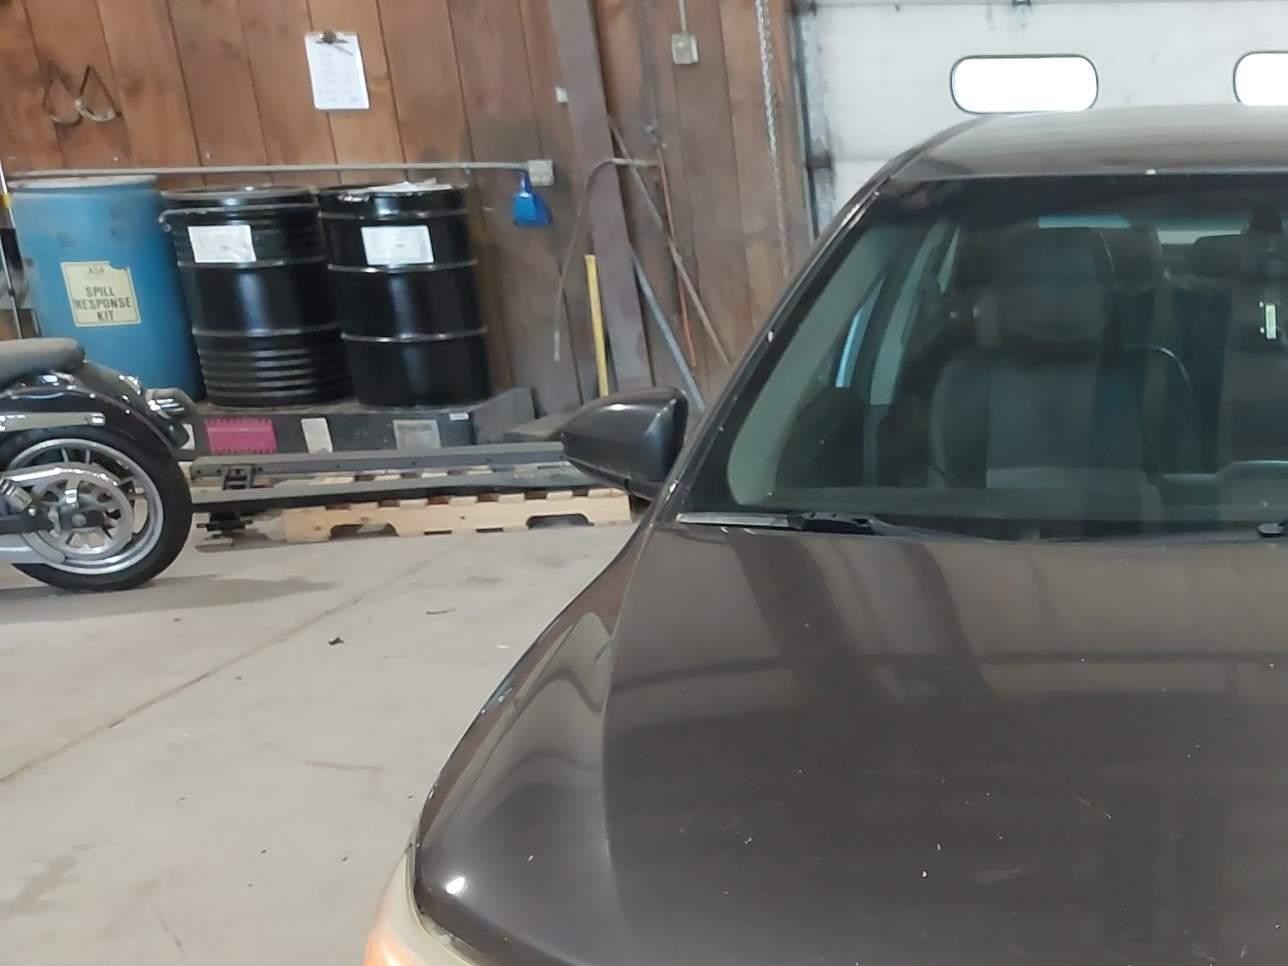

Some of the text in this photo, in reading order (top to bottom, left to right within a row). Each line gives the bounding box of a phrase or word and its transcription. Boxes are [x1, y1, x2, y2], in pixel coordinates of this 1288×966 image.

[85, 286, 115, 298] SPILL
[73, 297, 133, 310] RESPONSE
[96, 310, 114, 321] KIT
